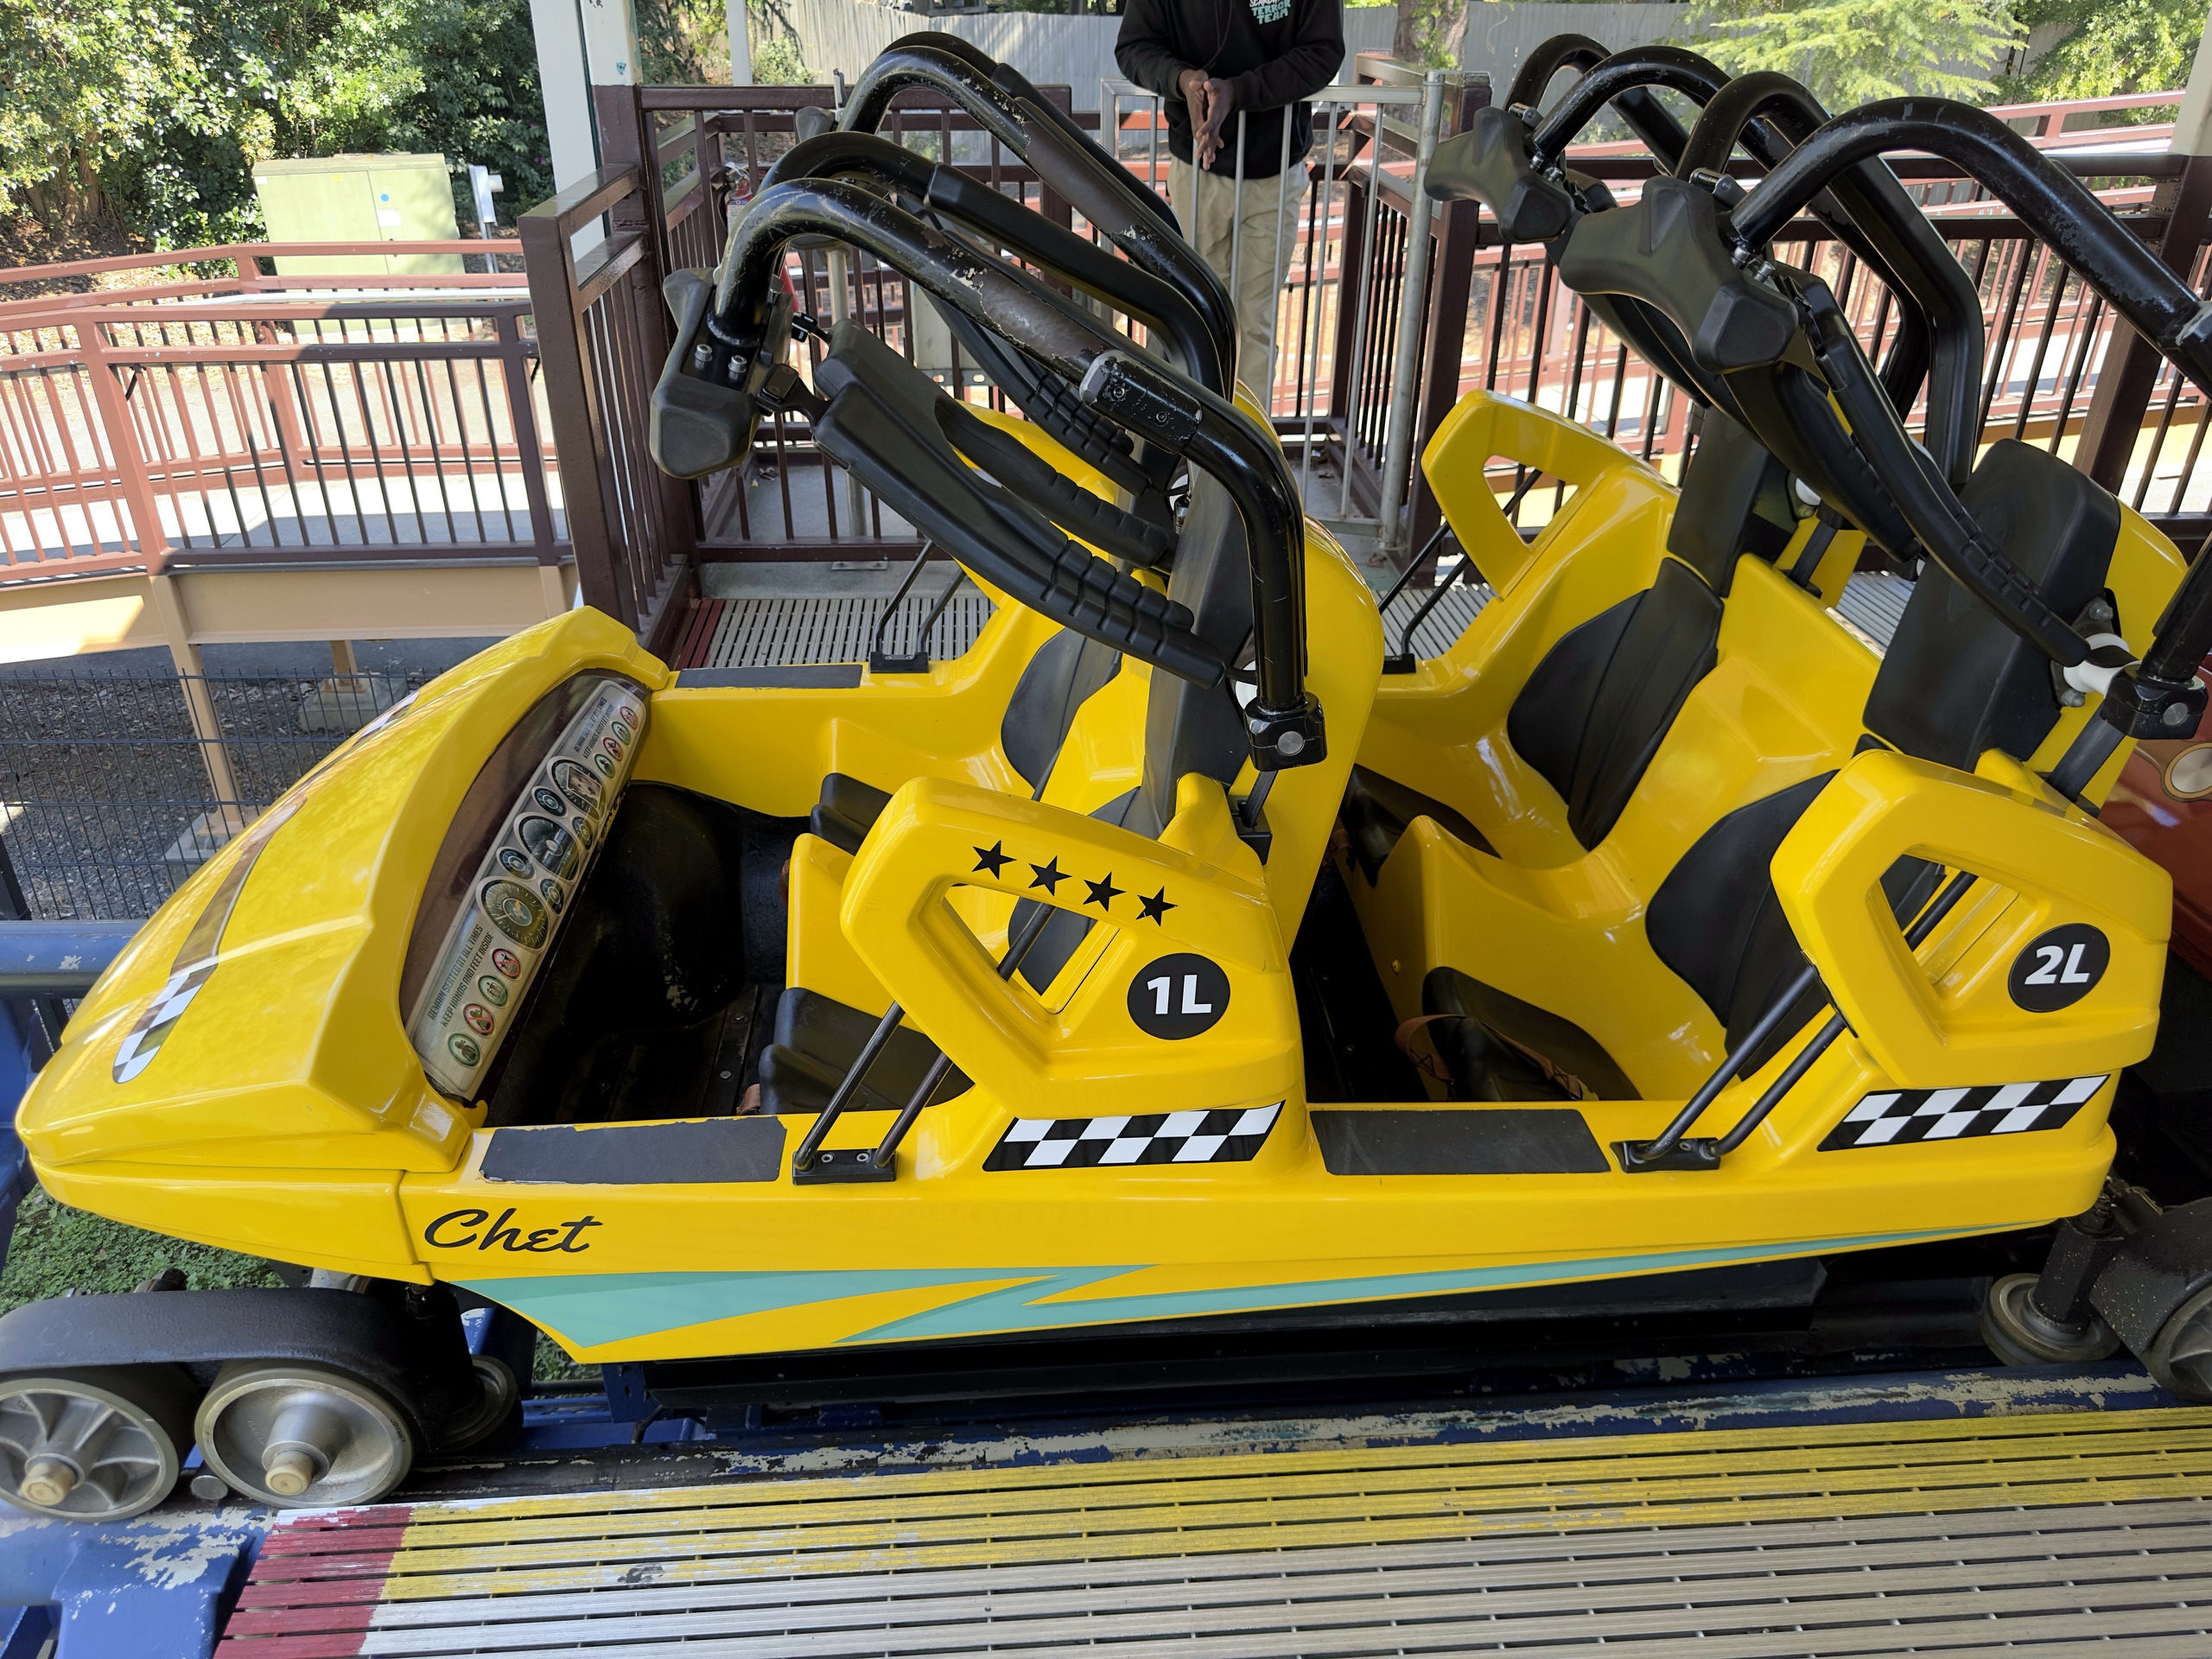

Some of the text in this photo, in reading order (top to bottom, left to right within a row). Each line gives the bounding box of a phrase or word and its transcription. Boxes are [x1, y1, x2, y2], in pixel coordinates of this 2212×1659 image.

[1251, 0, 1291, 16] TERROR
[1256, 9, 1288, 24] TEAM
[428, 990, 446, 1020] REMAIN
[442, 965, 461, 994] SEATED
[468, 924, 483, 946] TIMES
[441, 1007, 454, 1027] KEEP
[450, 982, 467, 1009] HANDS
[471, 952, 482, 971] FEET
[479, 931, 493, 956] INSIDE
[2024, 944, 2090, 985] 2L
[1147, 974, 1212, 1014] 1L
[424, 1208, 604, 1253] Chet
